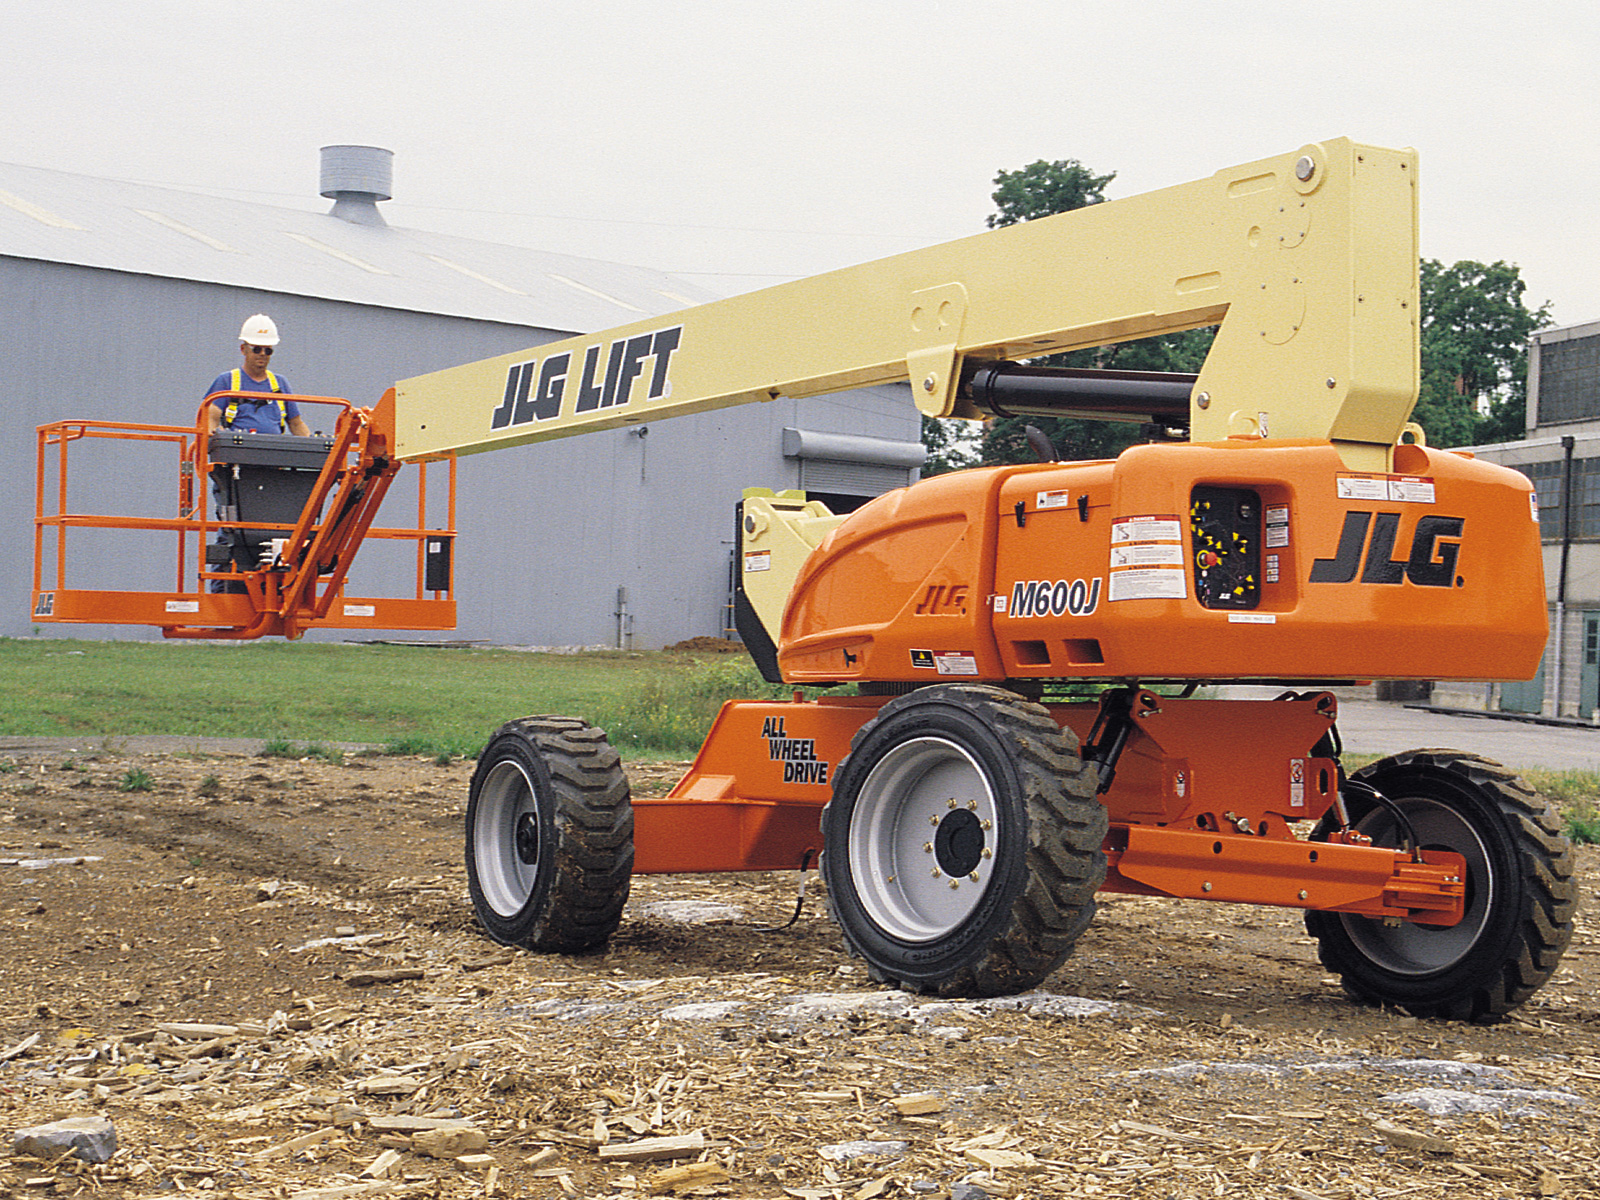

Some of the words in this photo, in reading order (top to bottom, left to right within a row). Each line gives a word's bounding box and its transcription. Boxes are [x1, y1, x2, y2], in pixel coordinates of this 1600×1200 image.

[492, 351, 573, 430] JLG
[575, 324, 684, 415] LIFT
[1309, 510, 1465, 588] JLG
[34, 592, 55, 616] JLG
[1009, 578, 1102, 618] M600J
[761, 716, 787, 738] ALL
[768, 739, 818, 760] WHEEL
[783, 761, 828, 785] DRIVE
